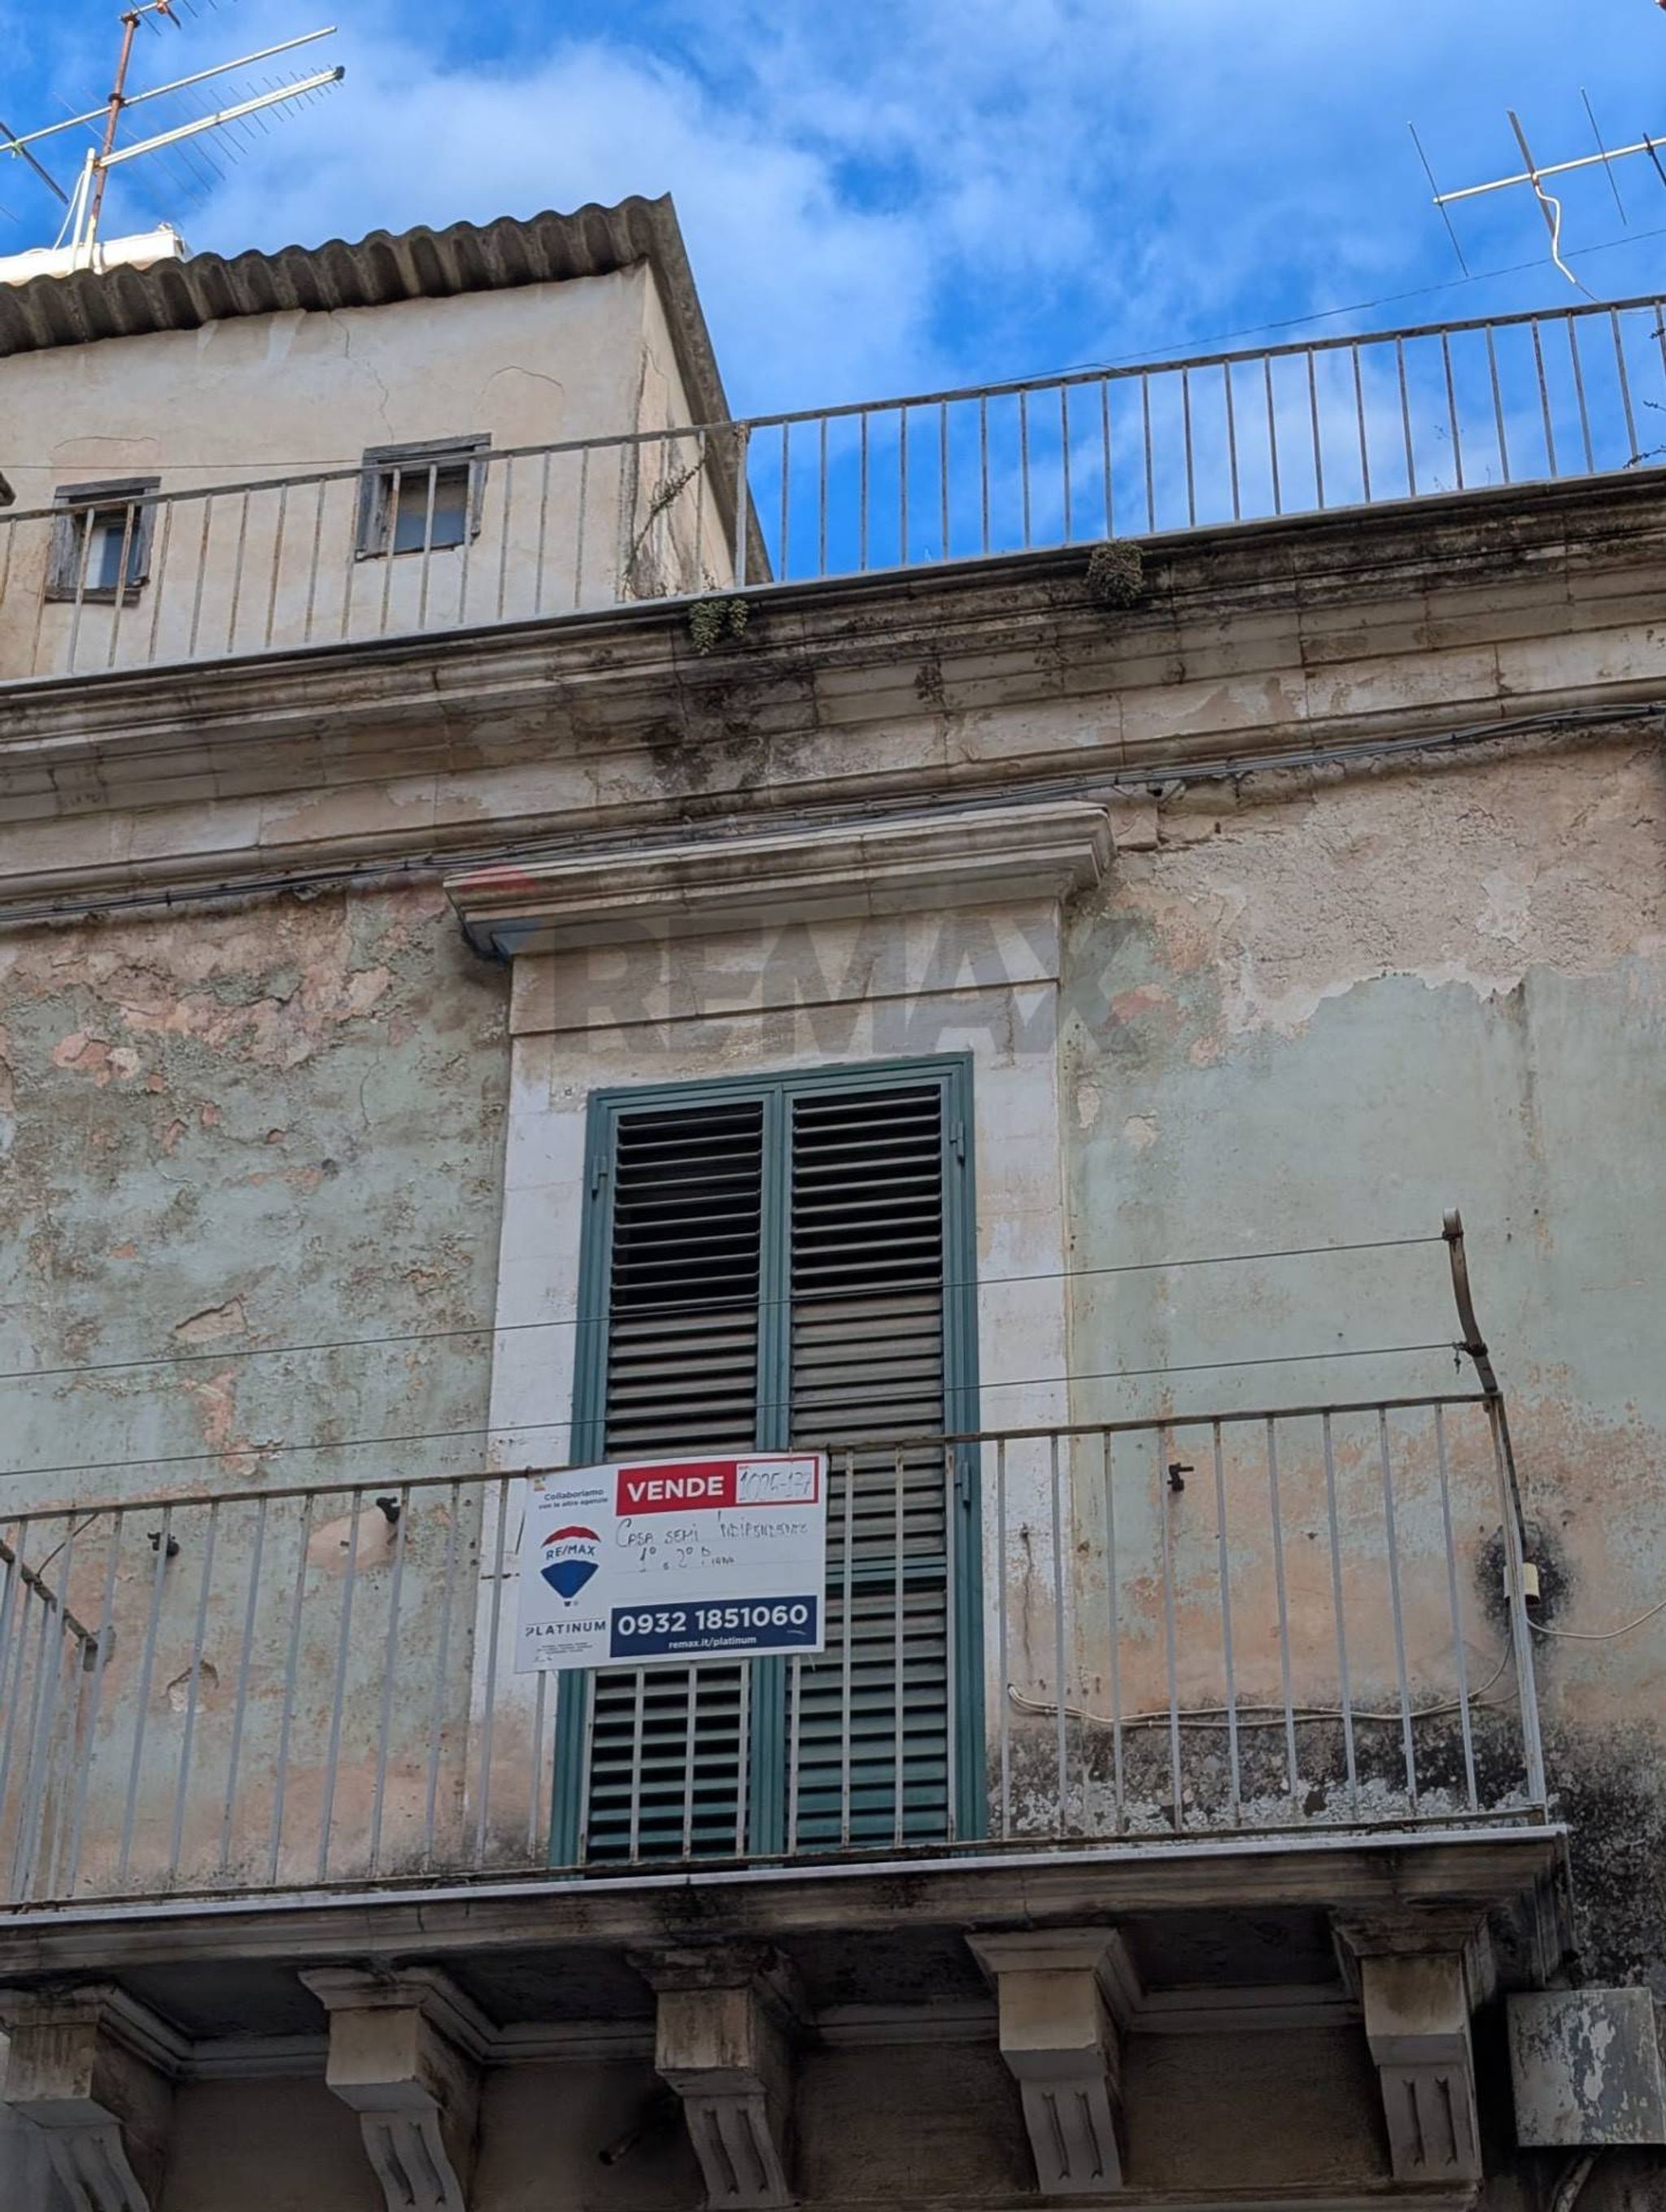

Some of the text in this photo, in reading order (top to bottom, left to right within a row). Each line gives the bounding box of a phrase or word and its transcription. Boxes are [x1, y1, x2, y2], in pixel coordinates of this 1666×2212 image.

[543, 1489, 604, 1501] Collaboriamo
[626, 1476, 725, 1503] VENDE
[546, 1544, 596, 1560] RE/MAX
[618, 1604, 809, 1636] 0932 1851060
[526, 1621, 606, 1637] PLATINUM
[668, 1635, 757, 1649] remax.it/platinum
